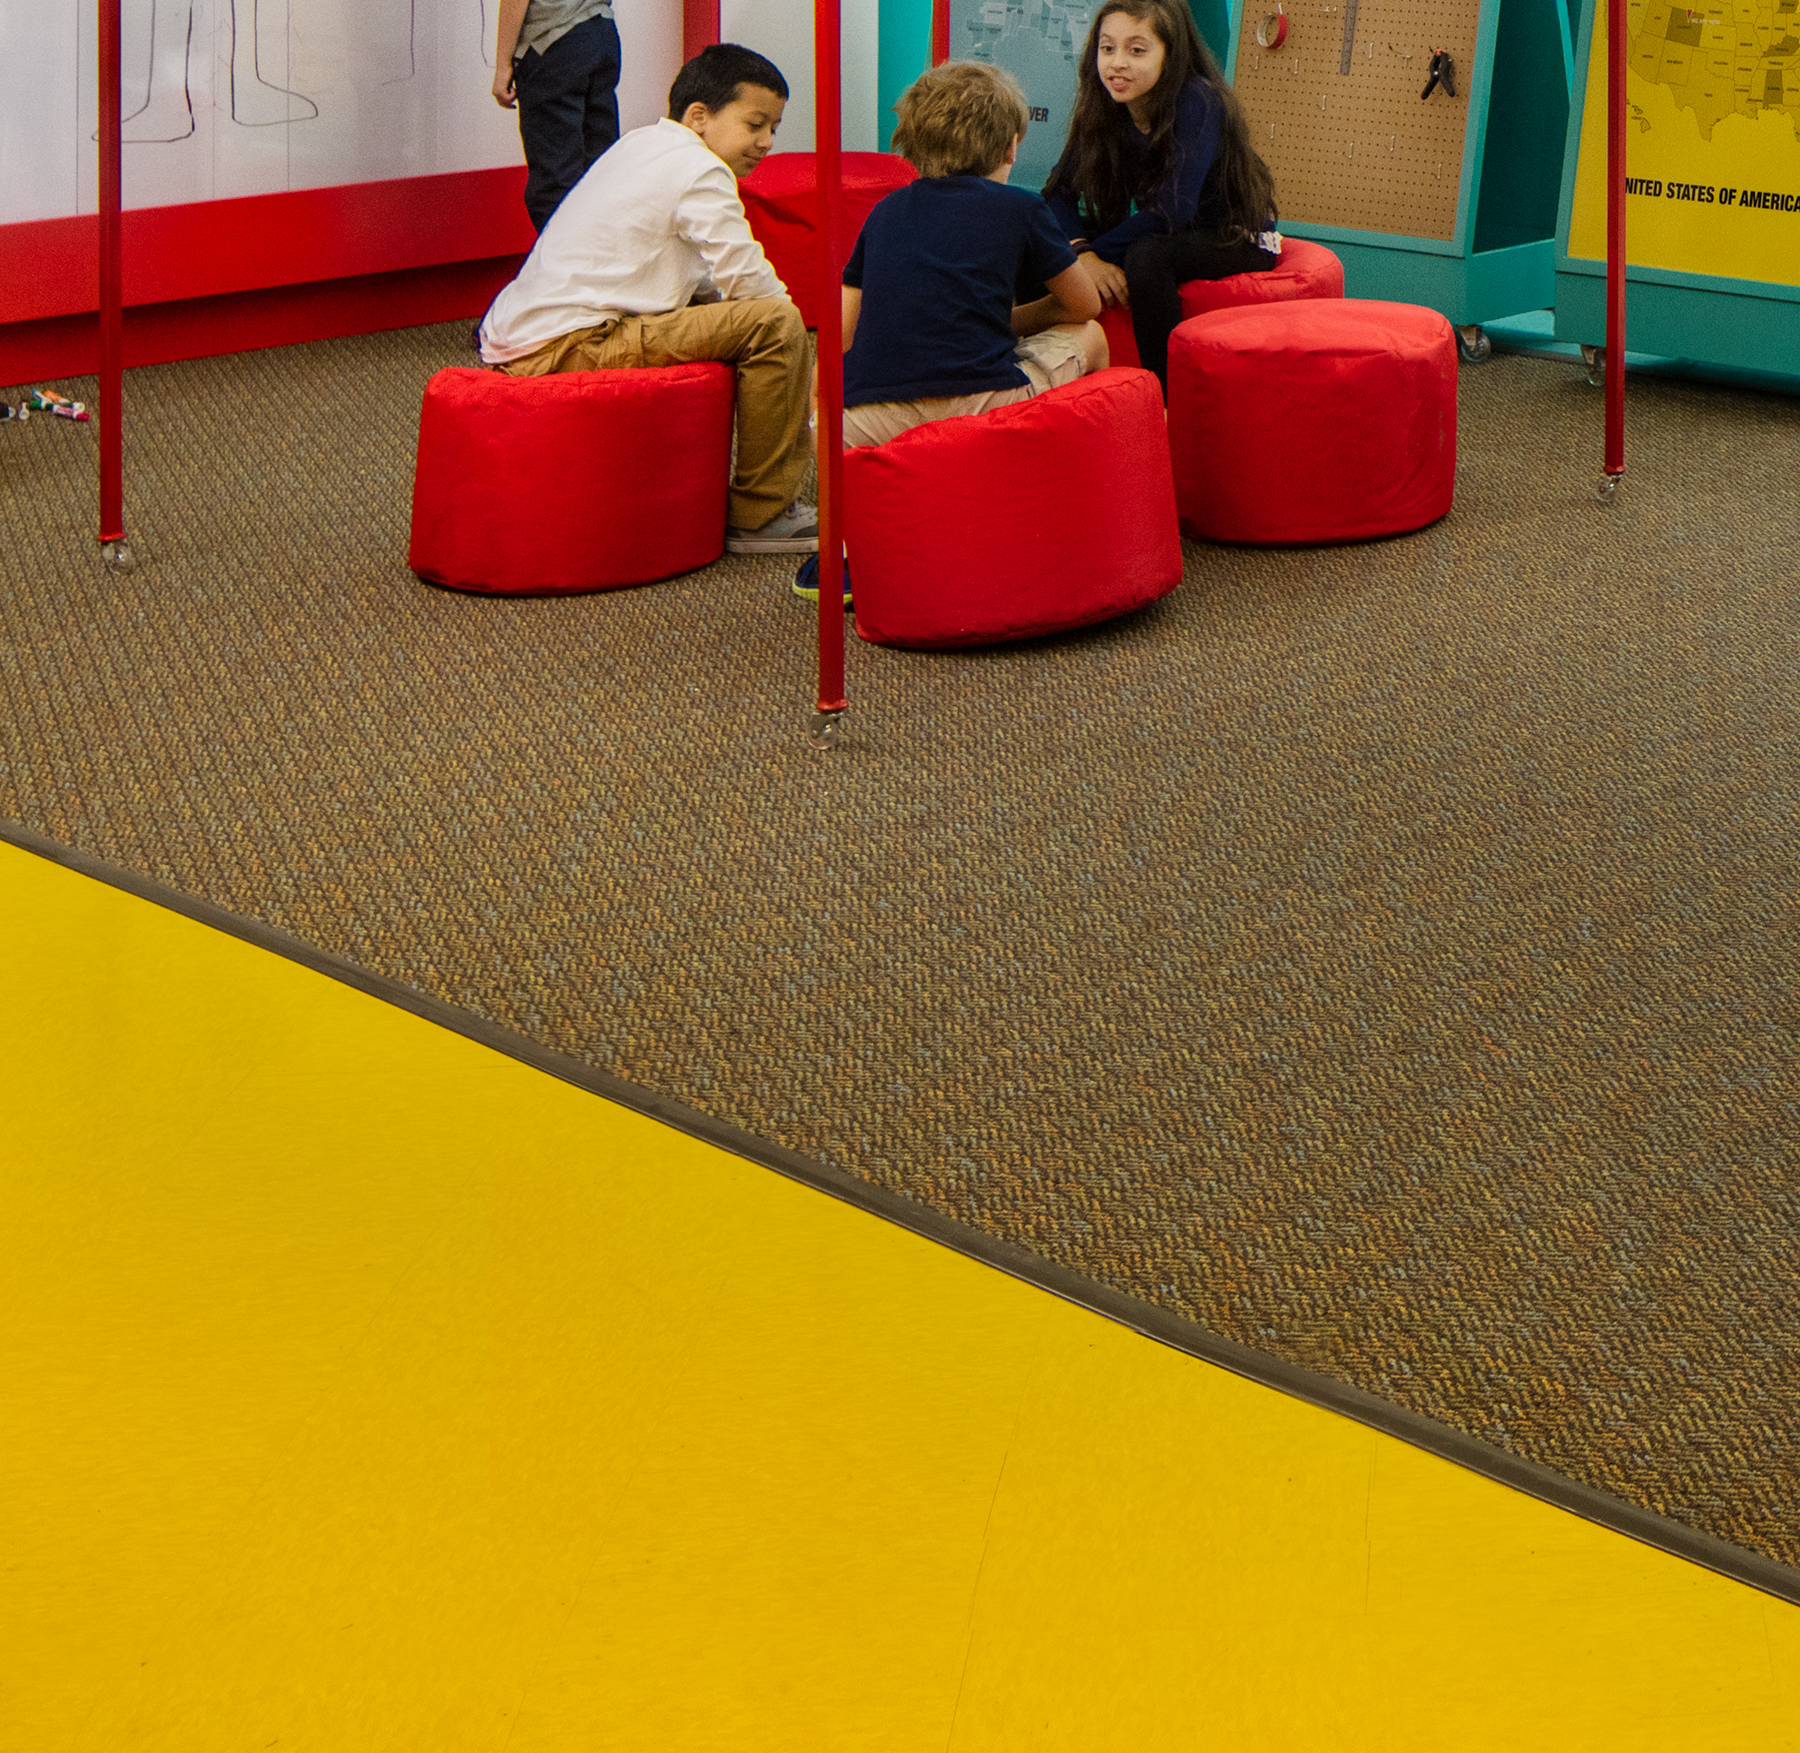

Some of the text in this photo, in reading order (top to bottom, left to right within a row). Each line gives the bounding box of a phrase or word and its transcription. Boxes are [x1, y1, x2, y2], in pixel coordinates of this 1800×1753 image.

[1625, 177, 1663, 198] NITED
[1666, 181, 1715, 204] STATES
[1719, 187, 1737, 205] OF
